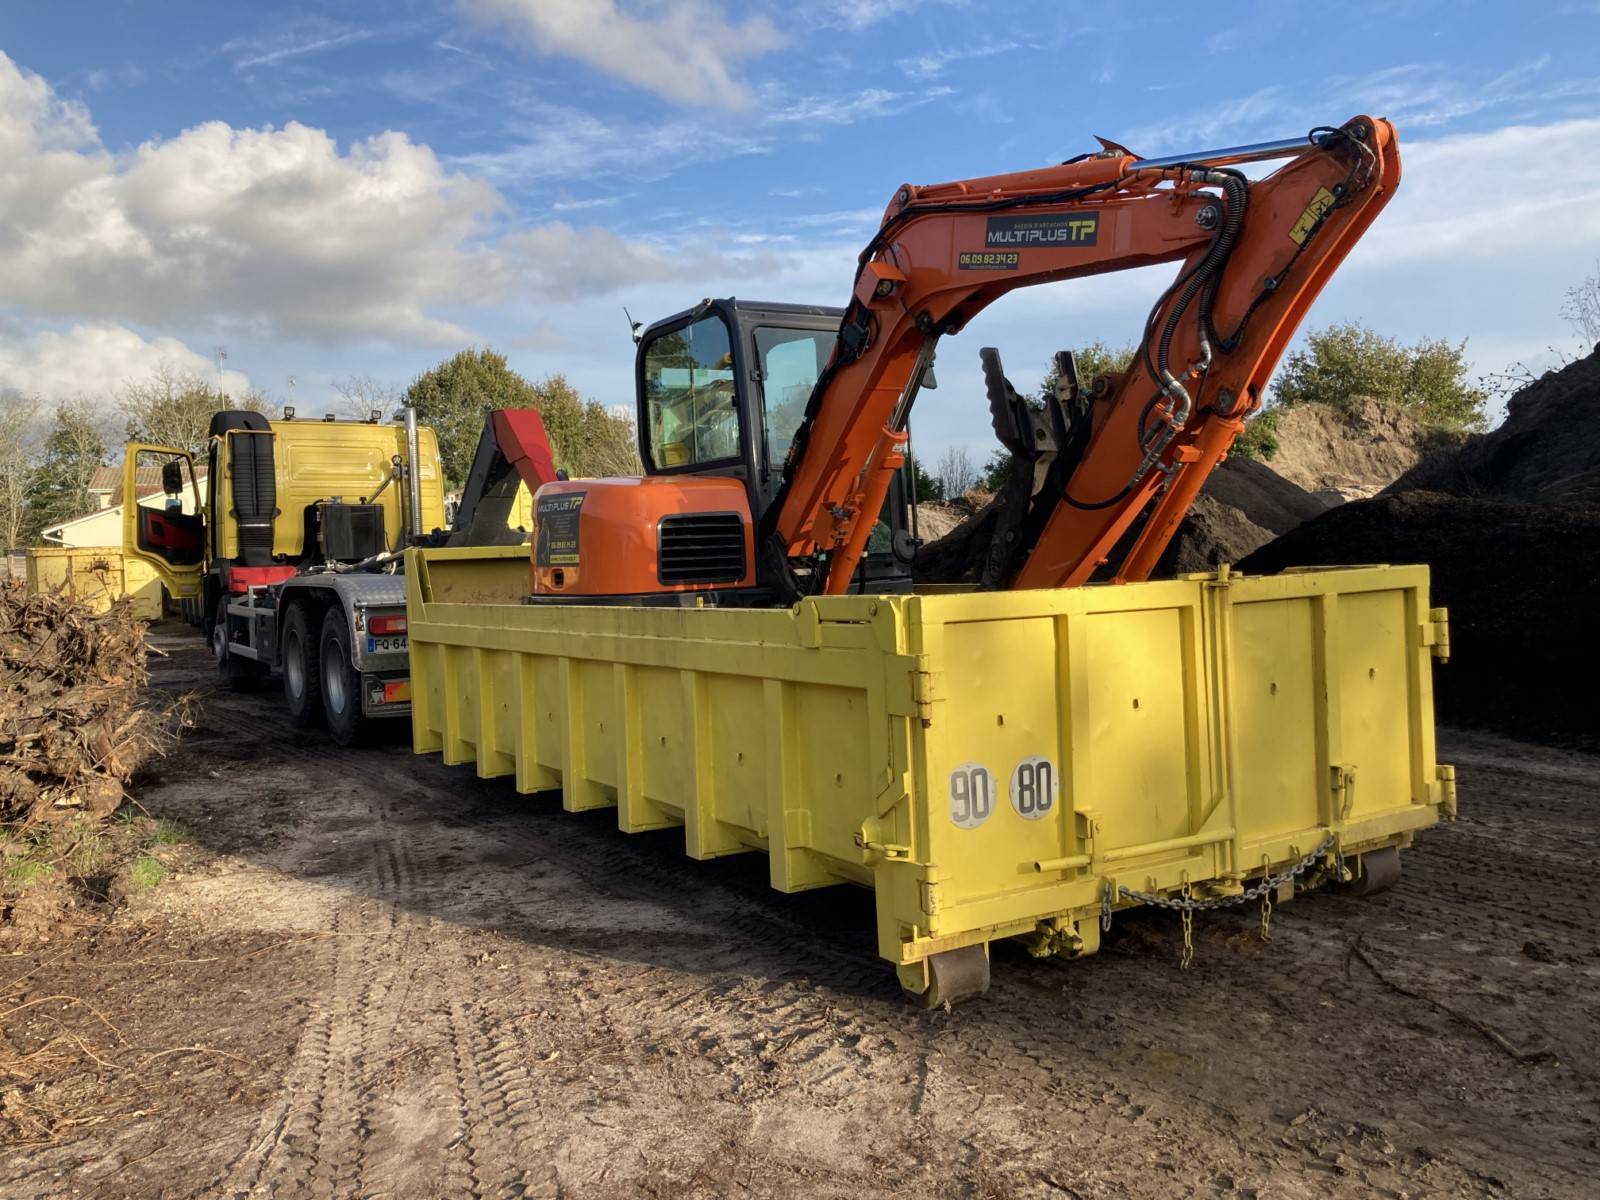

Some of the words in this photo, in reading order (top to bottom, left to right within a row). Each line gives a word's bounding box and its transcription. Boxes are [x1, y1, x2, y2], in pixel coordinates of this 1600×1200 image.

[375, 638, 408, 650] FQ-64
[951, 768, 989, 823] 90
[1018, 761, 1052, 814] 80
